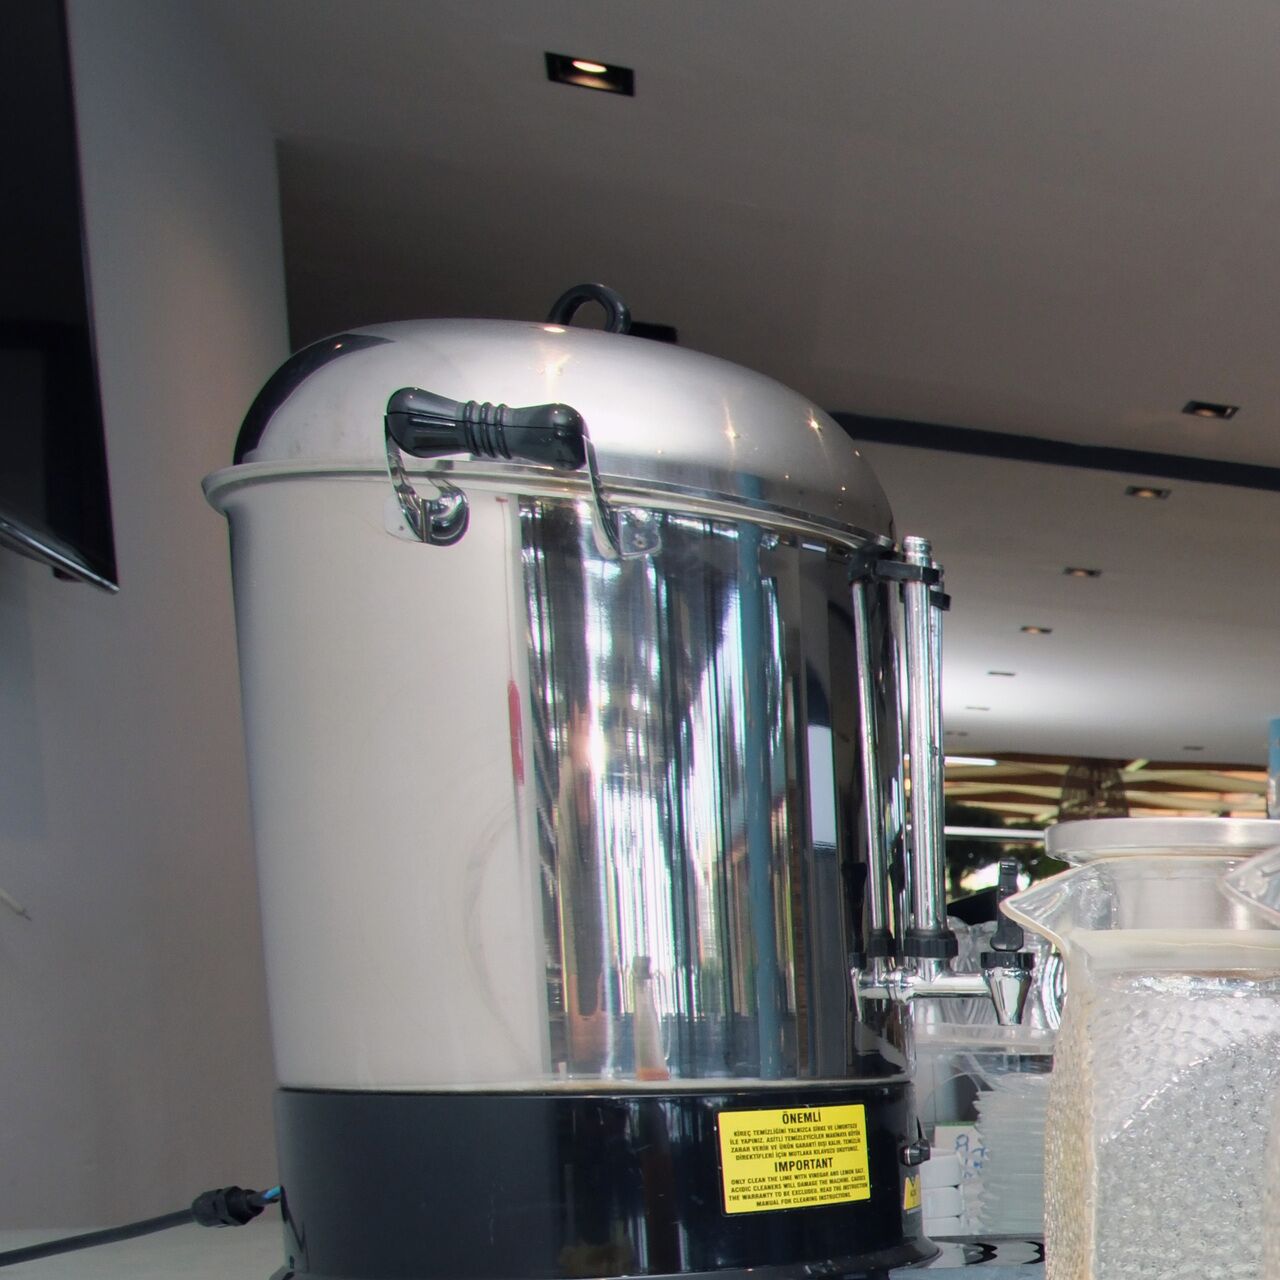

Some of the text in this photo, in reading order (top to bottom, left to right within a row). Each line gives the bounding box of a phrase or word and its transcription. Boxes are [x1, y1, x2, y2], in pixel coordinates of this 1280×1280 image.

[782, 1109, 822, 1125] ÖNEMLİ
[774, 1157, 833, 1173] IMPORTANT
[742, 1192, 773, 1200] WARRANTY
[756, 1199, 779, 1207] MANUAL
